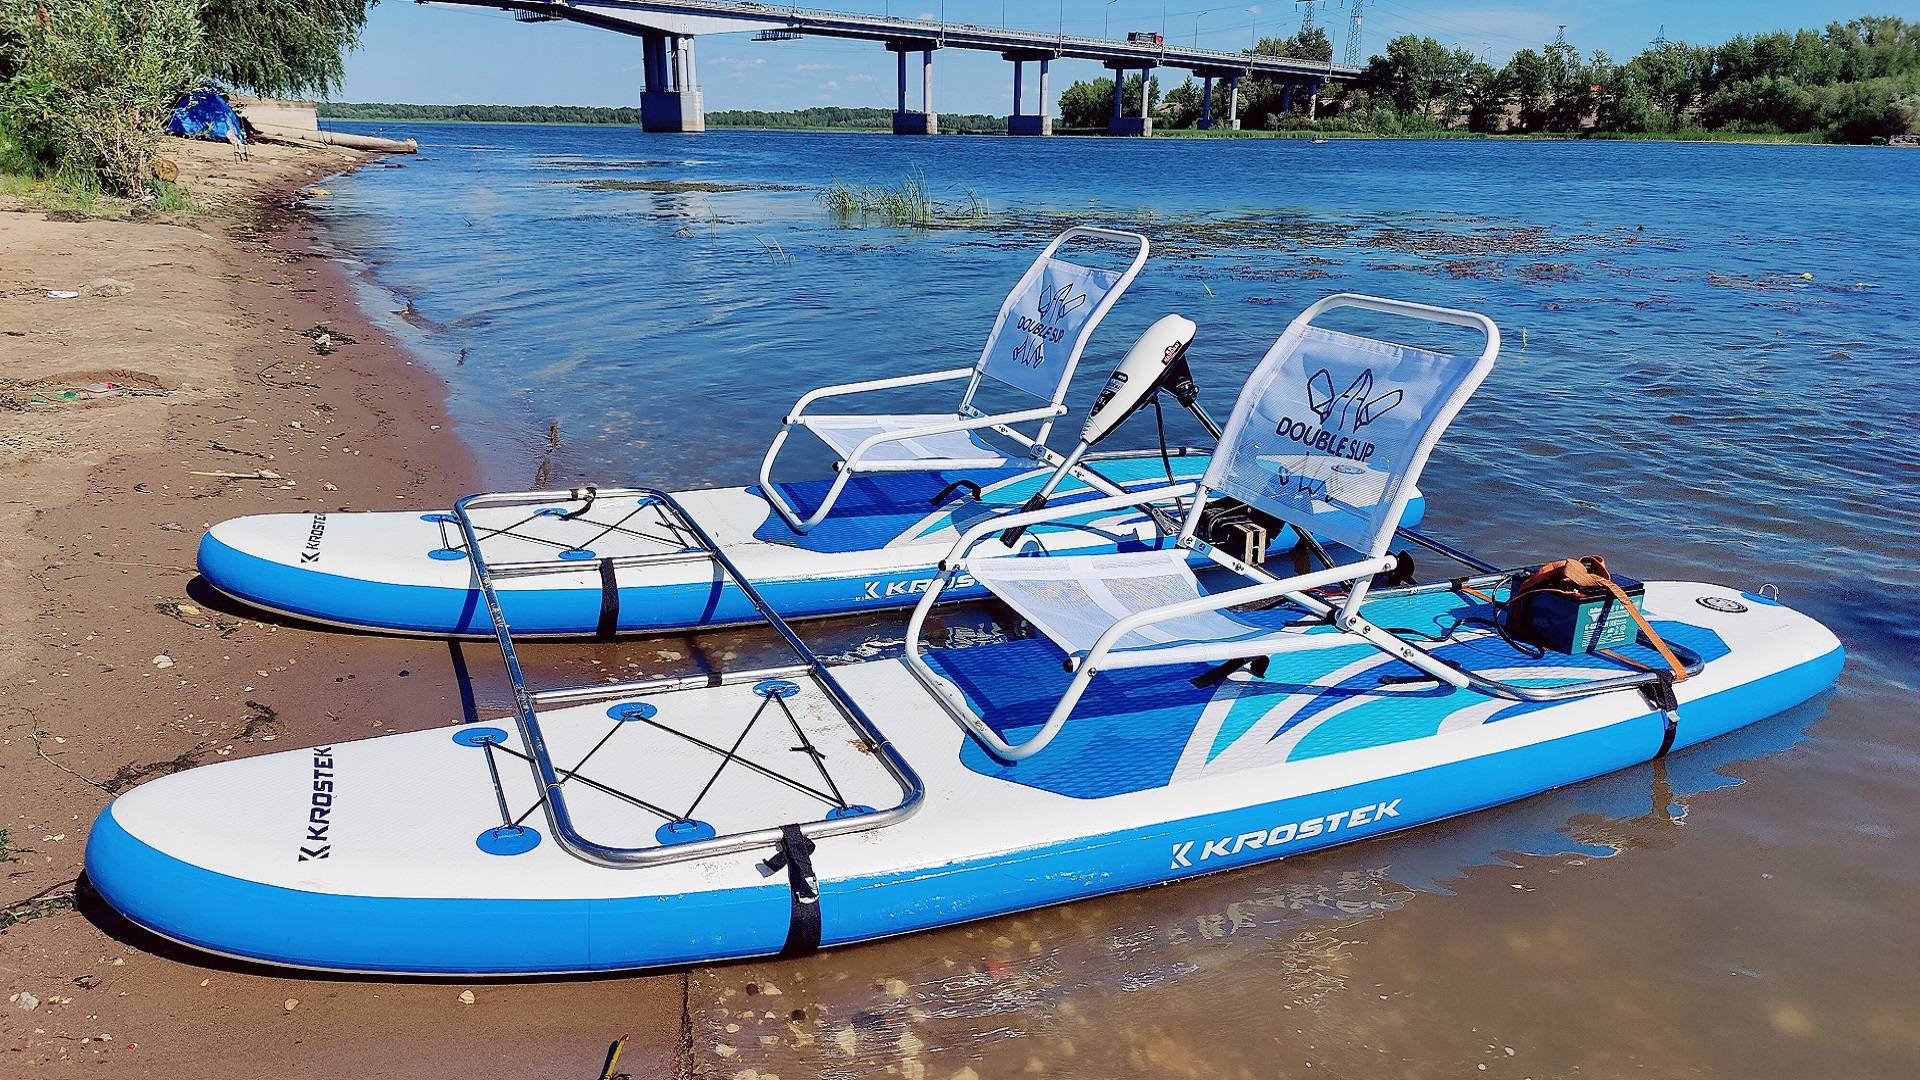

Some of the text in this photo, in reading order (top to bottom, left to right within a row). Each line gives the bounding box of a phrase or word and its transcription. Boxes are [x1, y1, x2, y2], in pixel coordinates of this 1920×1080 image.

[1017, 316, 1065, 344] DOUBLE SUP
[1276, 417, 1375, 462] DOUBLE SUP
[307, 747, 333, 841] KROSTEK
[1200, 799, 1402, 860] KROSTEK
